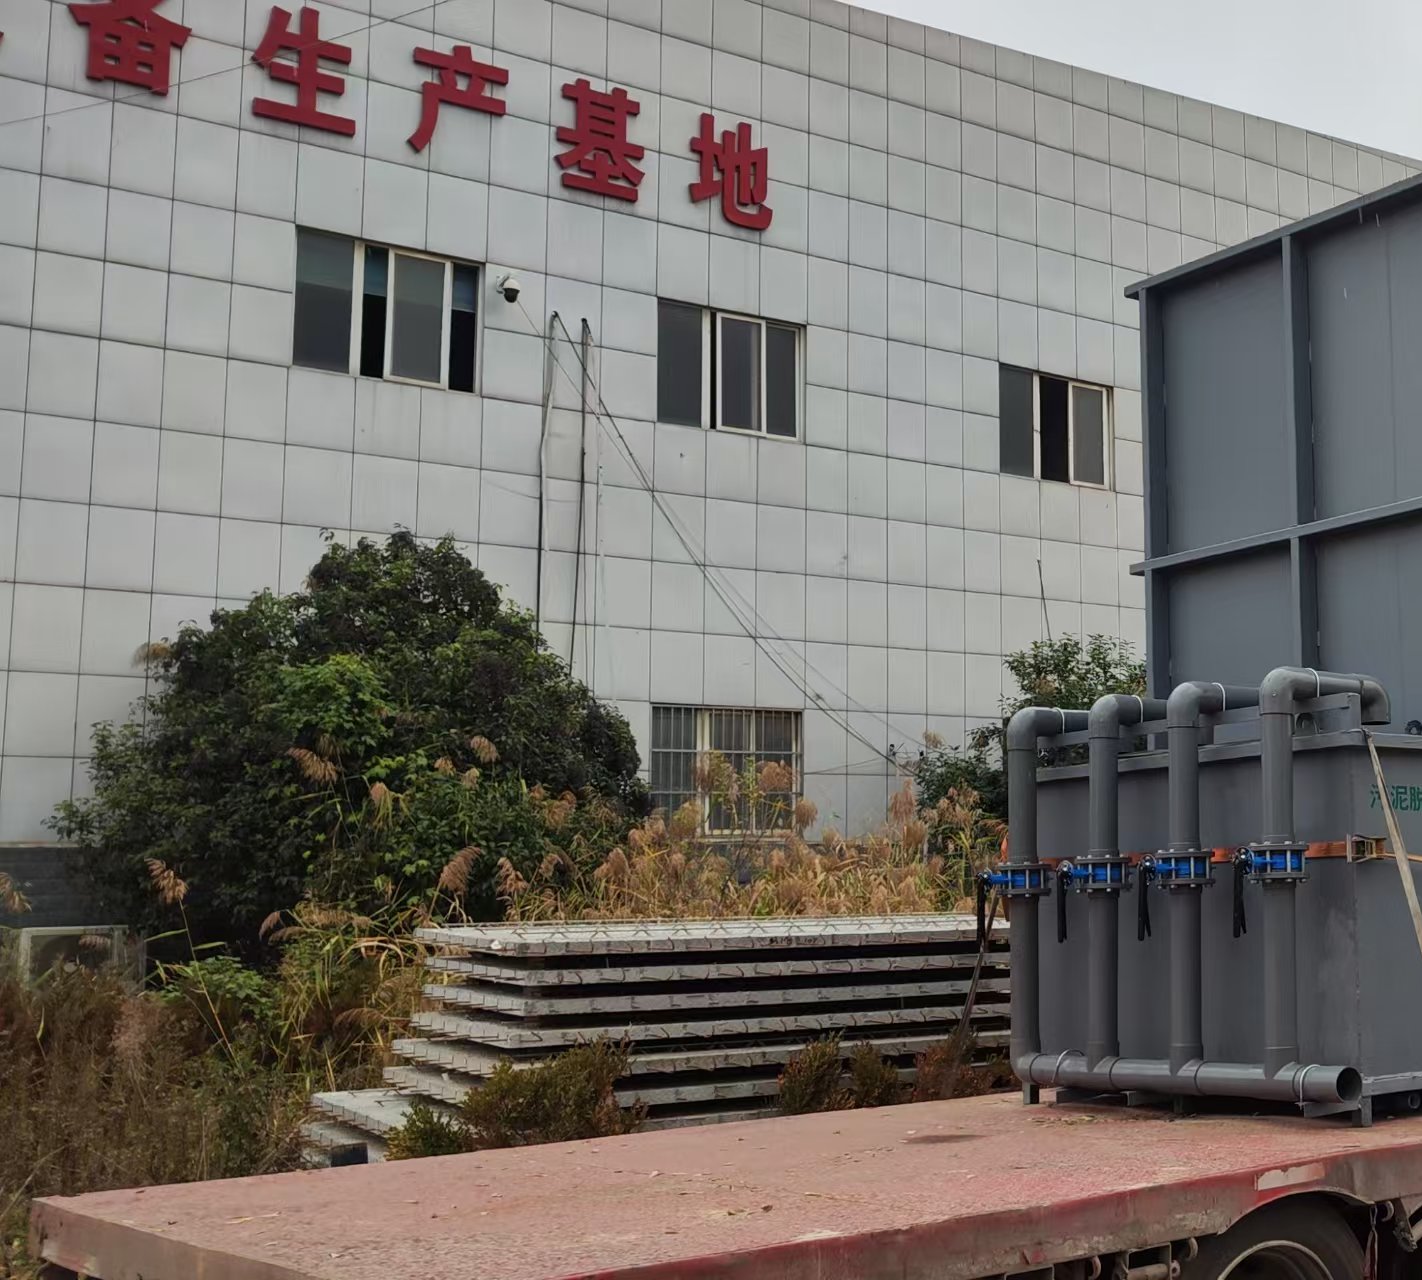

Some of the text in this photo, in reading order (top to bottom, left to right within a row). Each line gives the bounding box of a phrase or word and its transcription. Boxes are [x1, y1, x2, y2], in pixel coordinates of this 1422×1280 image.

[0, 0, 772, 231] 备生产基地
